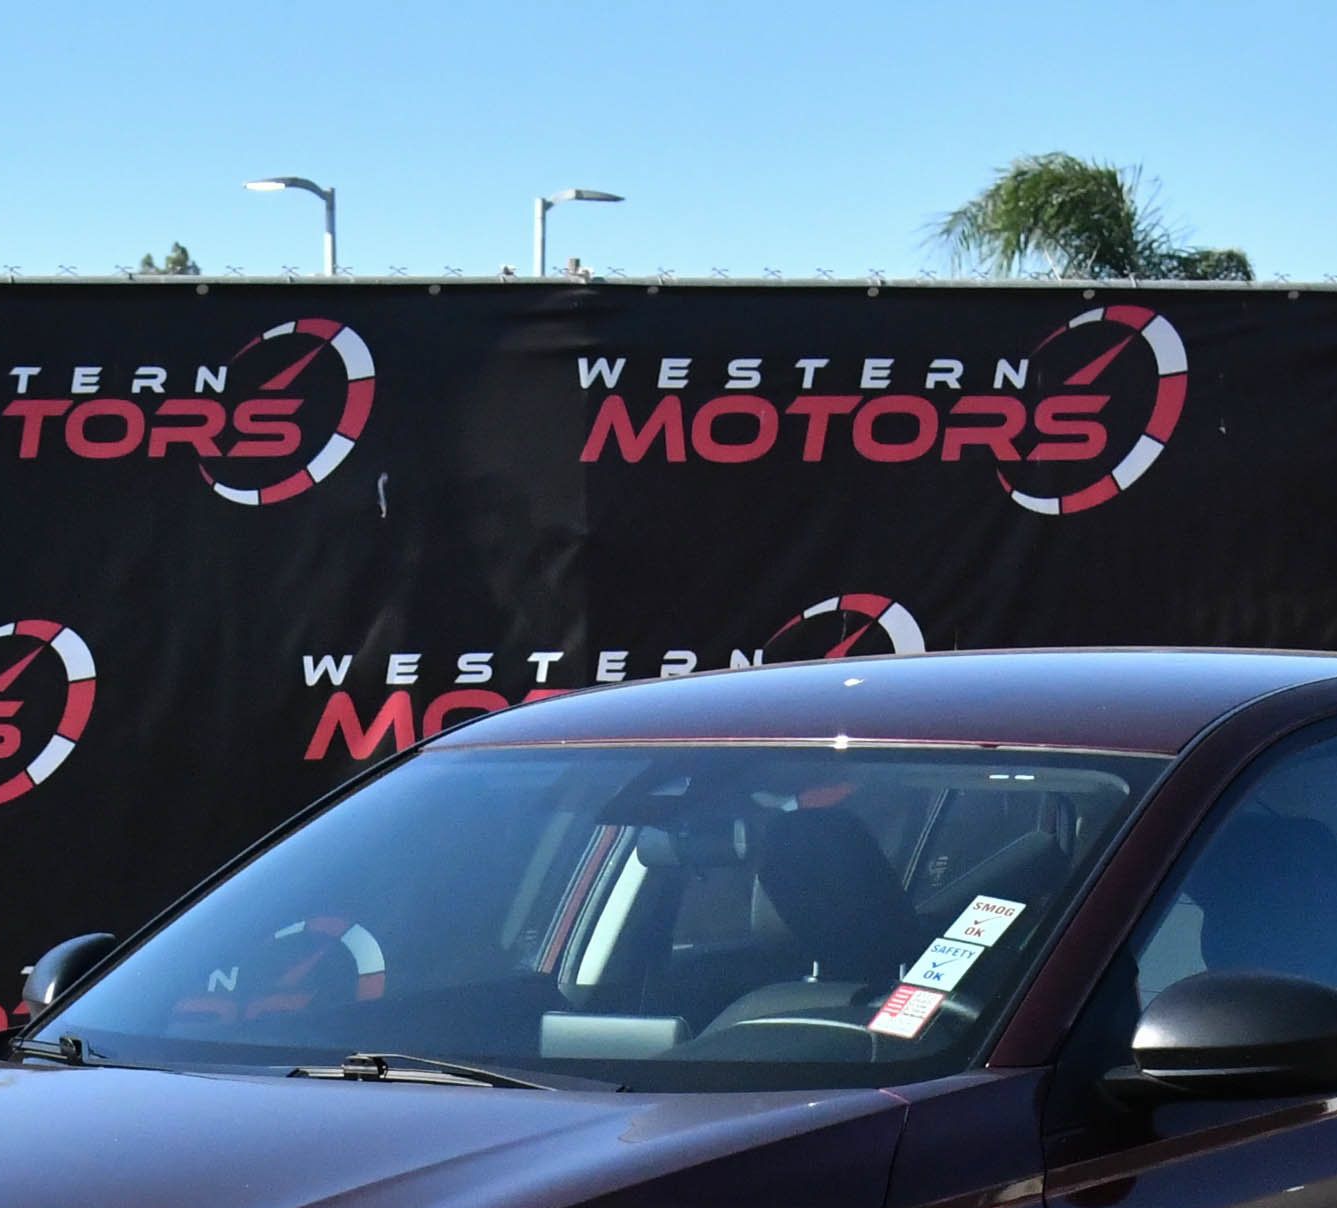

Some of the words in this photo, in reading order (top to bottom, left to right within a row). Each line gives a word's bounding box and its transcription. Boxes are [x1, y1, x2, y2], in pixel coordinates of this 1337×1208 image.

[578, 357, 1030, 390] WESTERN
[579, 395, 1112, 464] MOTORS
[972, 901, 1016, 918] SMOG
[964, 926, 985, 938] OK
[930, 944, 976, 959] SAFETY
[922, 969, 944, 982] OK
